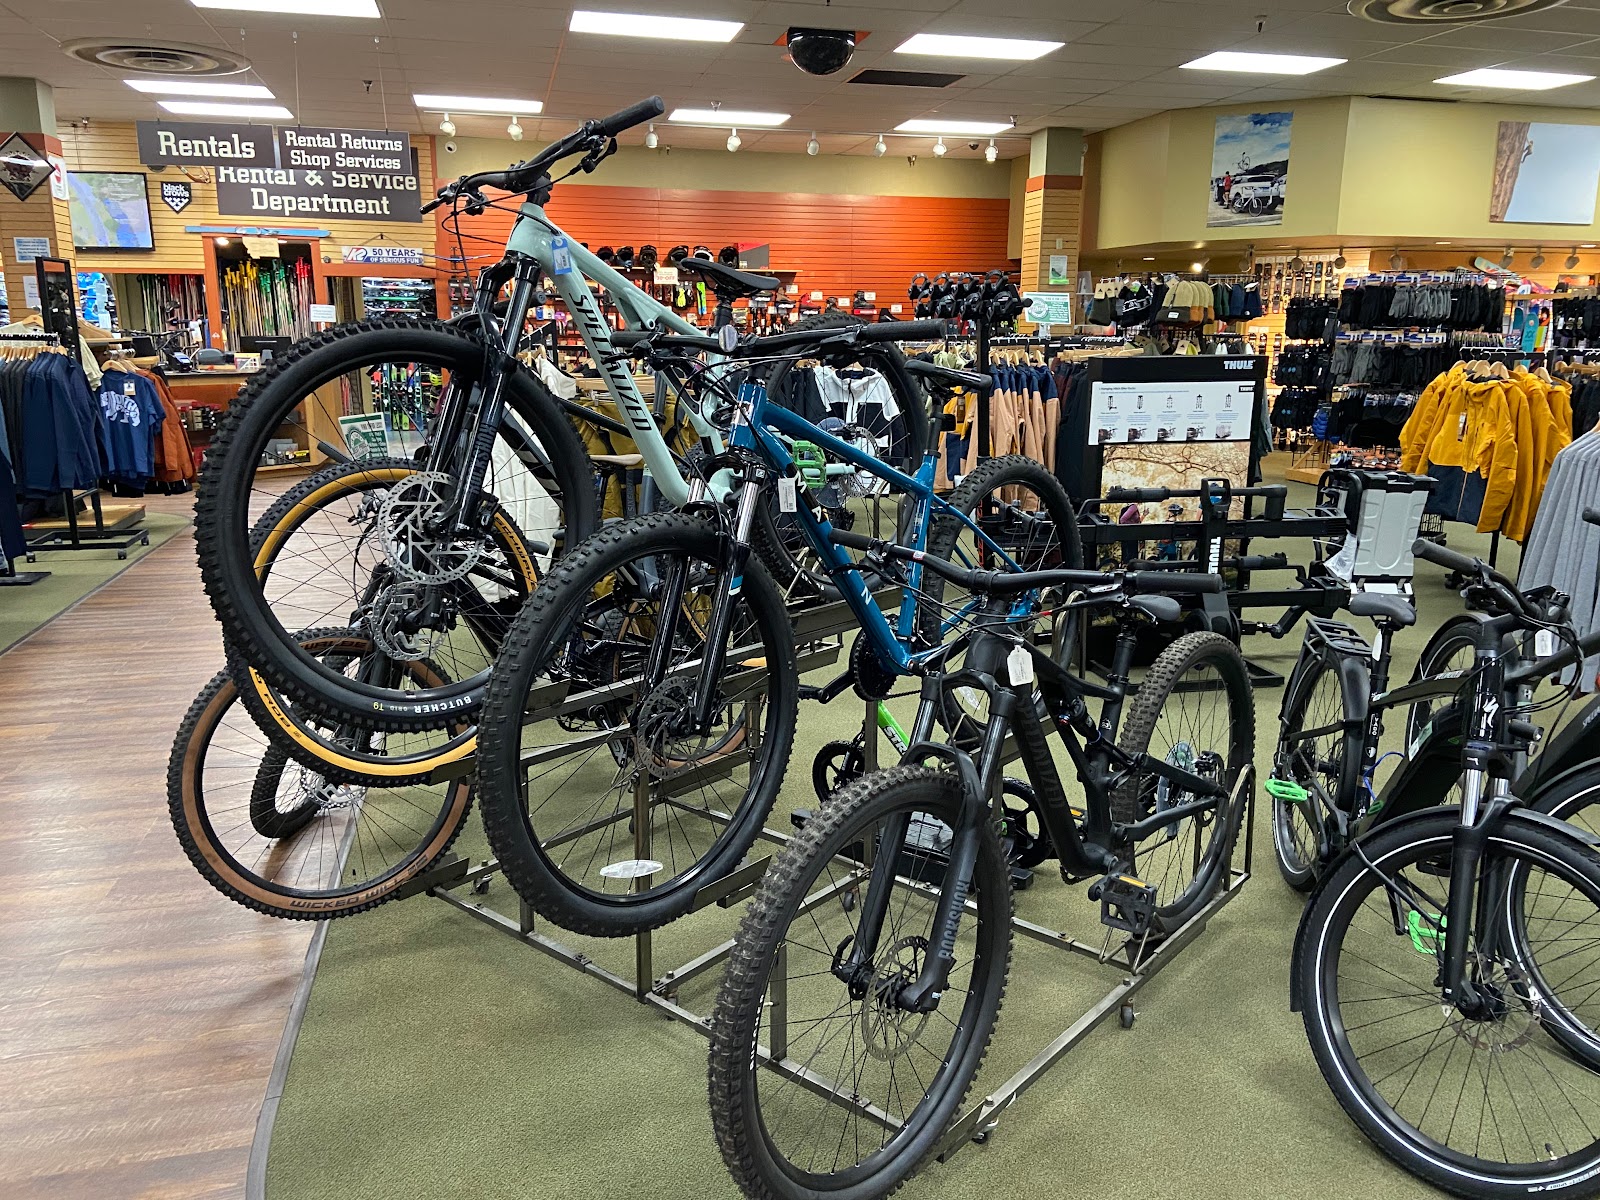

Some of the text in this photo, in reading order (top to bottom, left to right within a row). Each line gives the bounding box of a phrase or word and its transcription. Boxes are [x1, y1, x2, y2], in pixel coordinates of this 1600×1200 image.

[157, 130, 256, 159] Rentals
[284, 130, 403, 152] Rental Returns
[290, 149, 401, 170] Shop Services
[163, 182, 185, 191] black
[219, 166, 417, 191] Rental & Service
[163, 189, 190, 197] crows
[250, 187, 391, 216] Department
[346, 247, 368, 262] K2
[372, 248, 416, 257] 50 YEARS
[568, 292, 653, 431] SPECIALIZED
[1223, 360, 1254, 370] THULE
[794, 469, 873, 606] MAN
[373, 701, 385, 712] T9
[413, 695, 473, 714] BUTCHER
[289, 896, 361, 909] WICKED
[937, 880, 970, 960] ROCKSHOX
